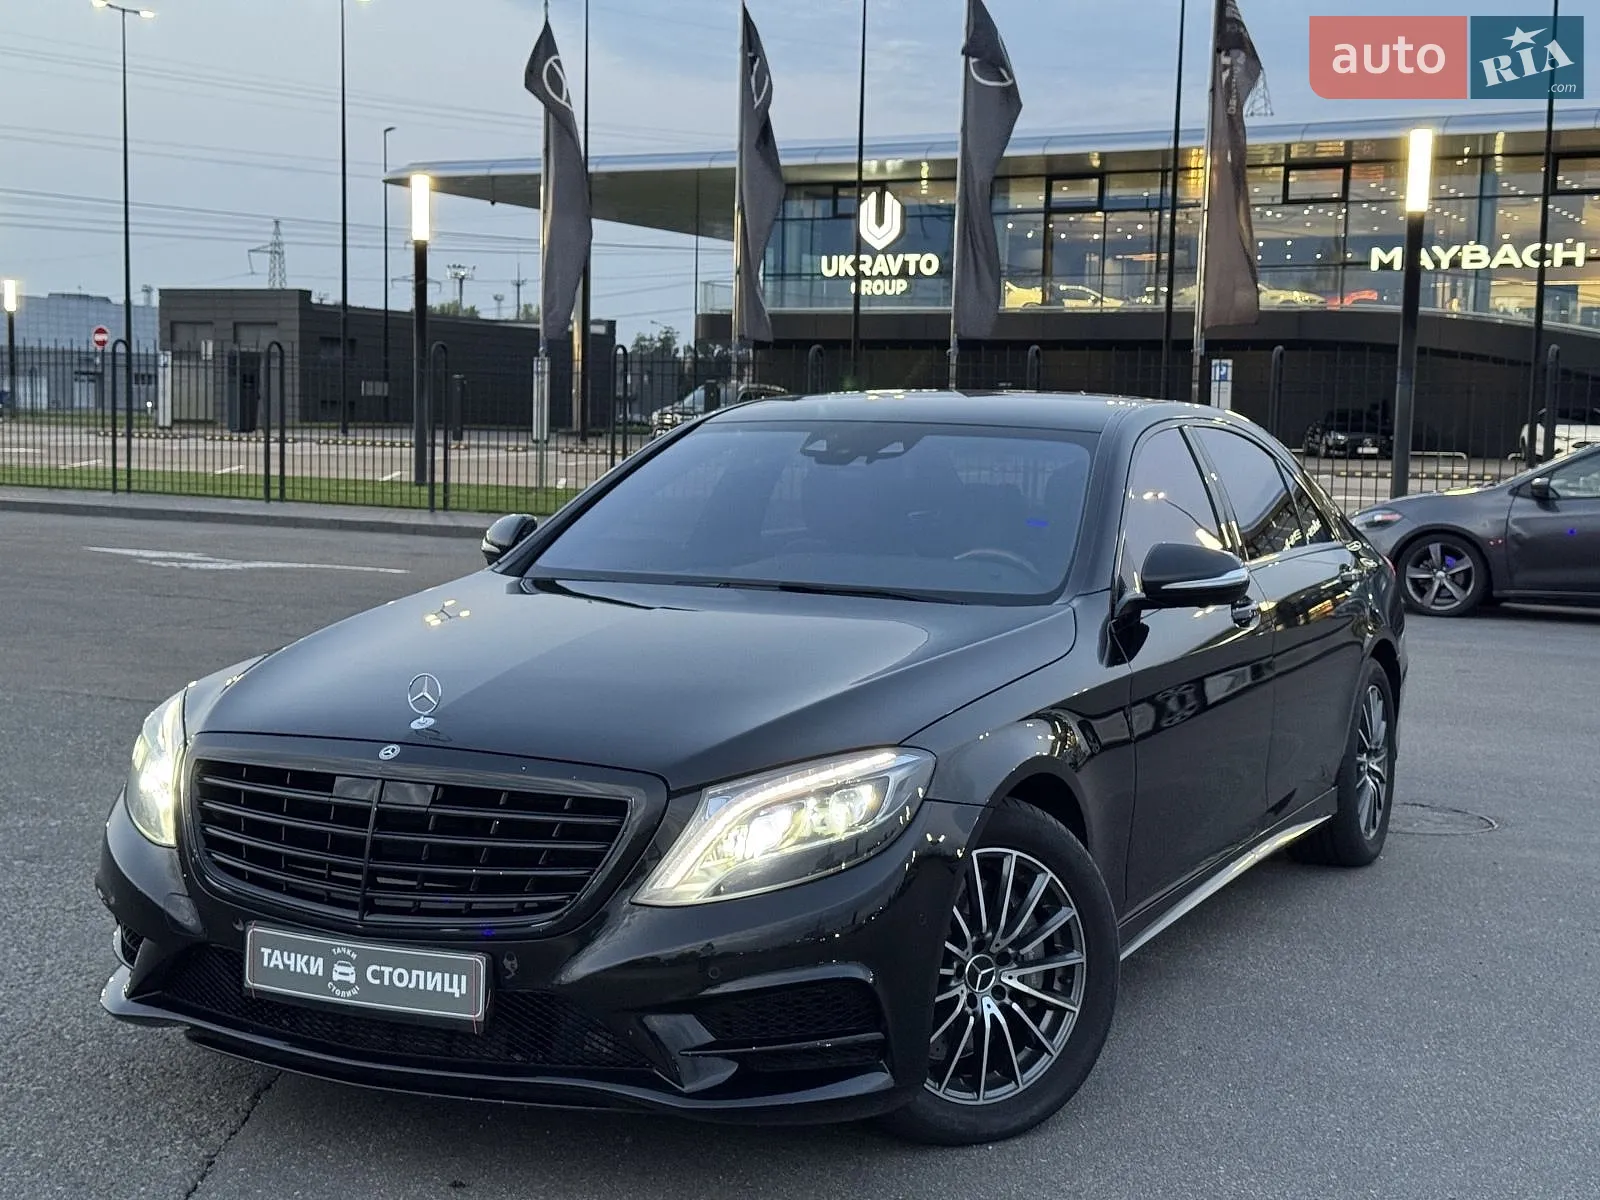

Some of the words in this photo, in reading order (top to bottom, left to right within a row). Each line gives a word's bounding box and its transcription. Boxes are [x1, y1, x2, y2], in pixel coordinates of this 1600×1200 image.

[821, 253, 940, 277] UKRAVTO
[332, 947, 358, 960] ТАЧКИ
[260, 946, 324, 977] ТАЧКИ
[366, 964, 467, 998] СТОЛИЦІ
